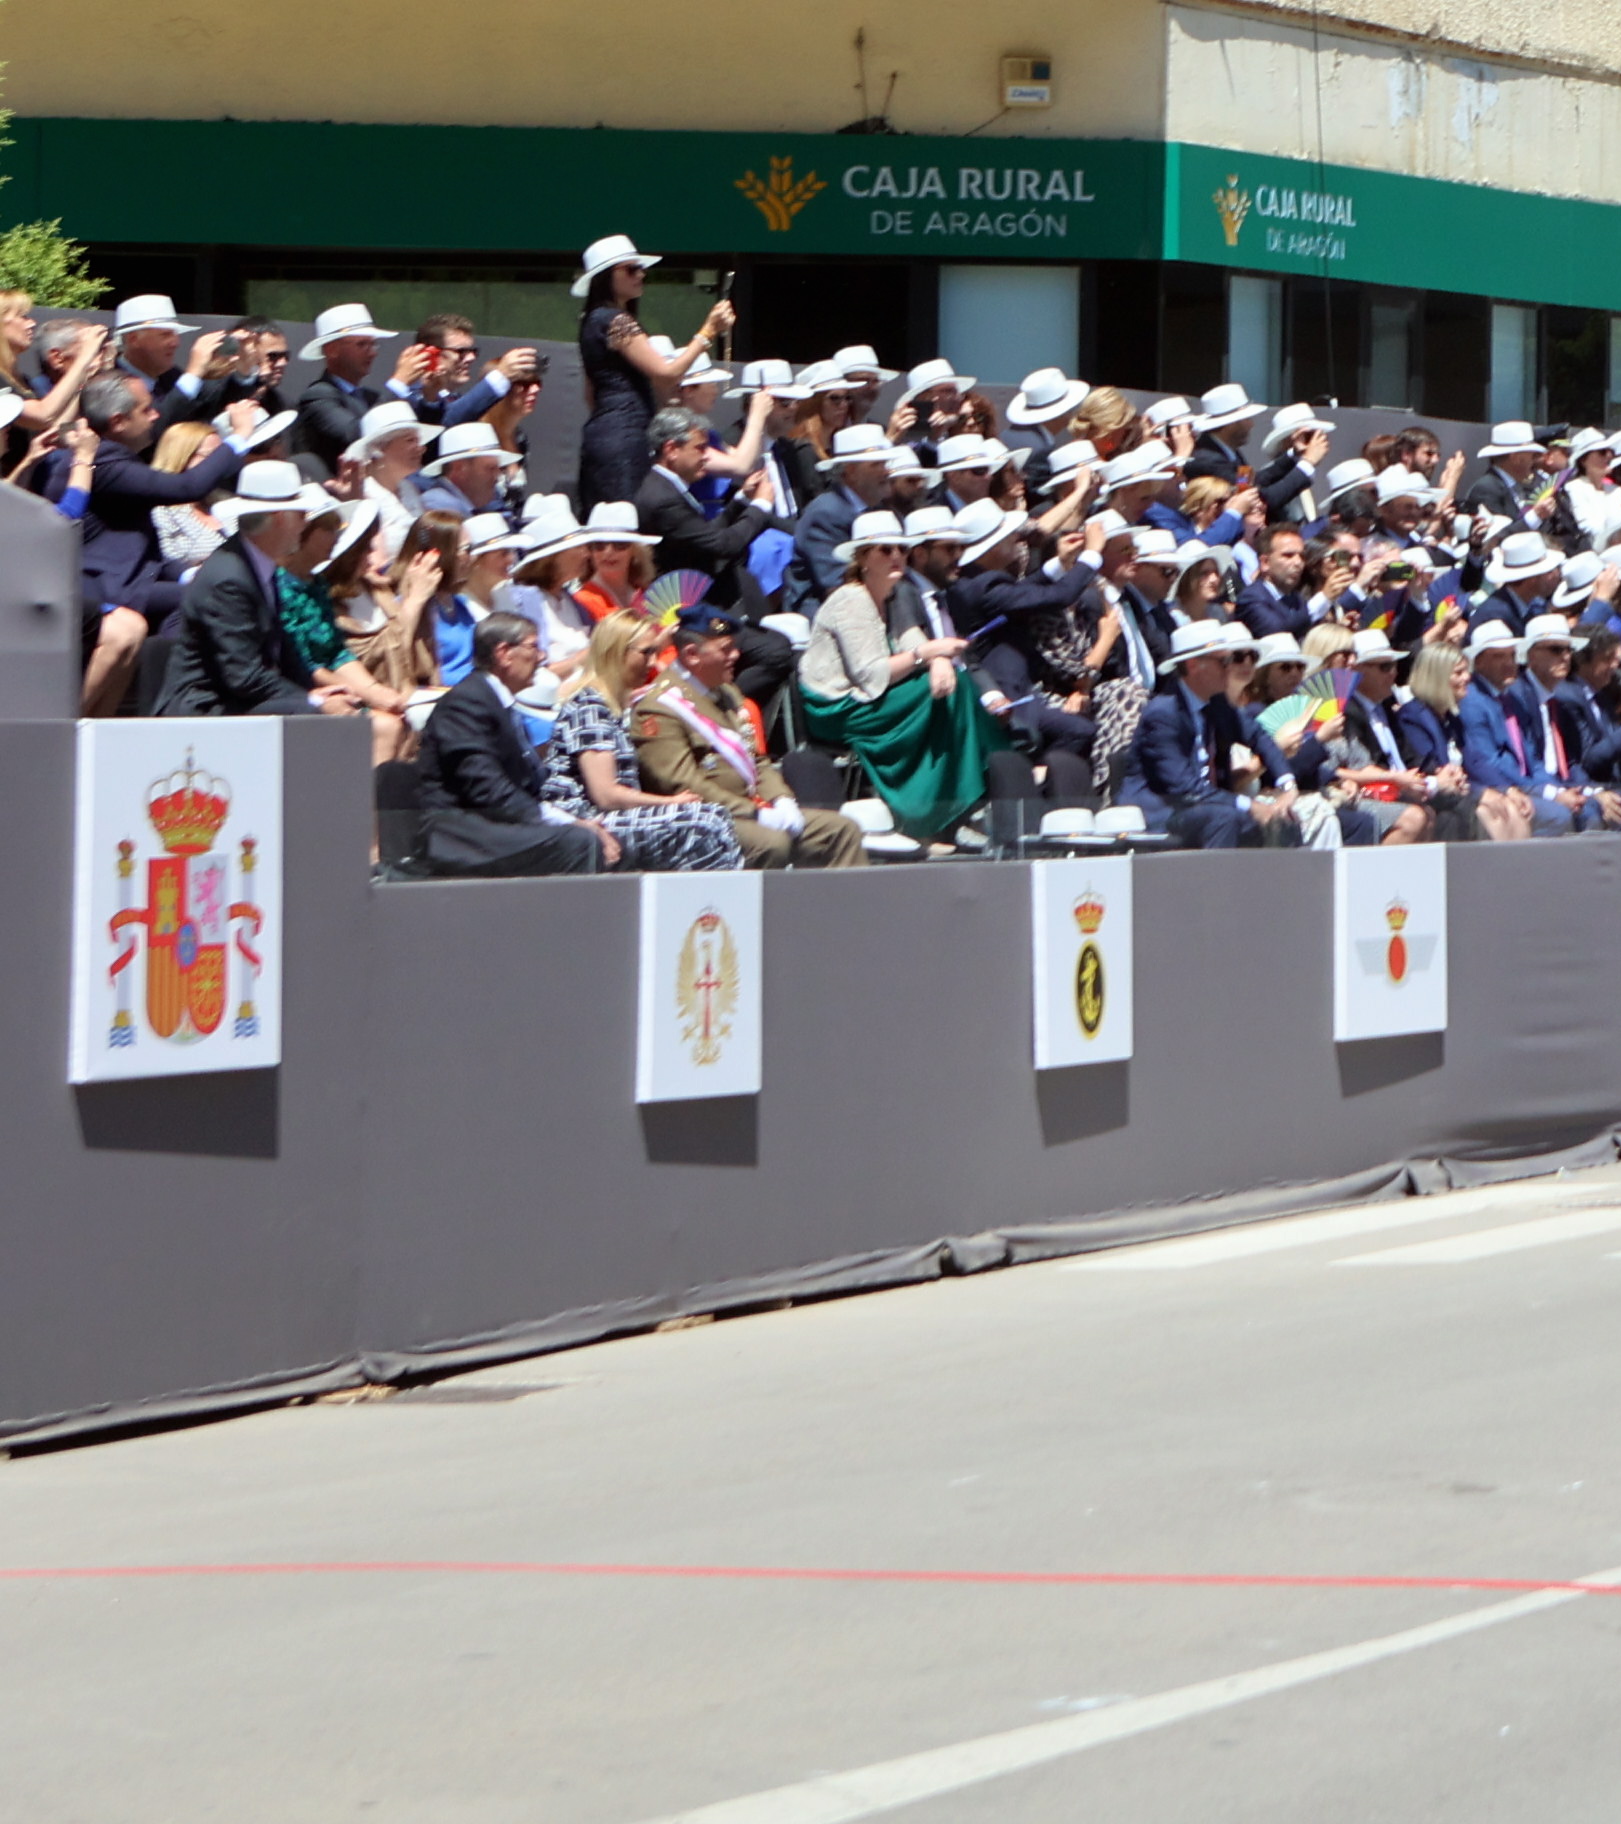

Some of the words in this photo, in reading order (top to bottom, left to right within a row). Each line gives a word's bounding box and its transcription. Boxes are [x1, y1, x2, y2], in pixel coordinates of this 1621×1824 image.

[842, 165, 948, 199] CAJA
[957, 167, 1095, 202] RURAL
[870, 210, 914, 235] DE
[923, 207, 1068, 237] ARAGÓN
[1255, 184, 1299, 220] CAJA
[1300, 190, 1356, 227] RURAL
[1266, 227, 1285, 252] DE
[1287, 231, 1346, 260] ARAGÓN
